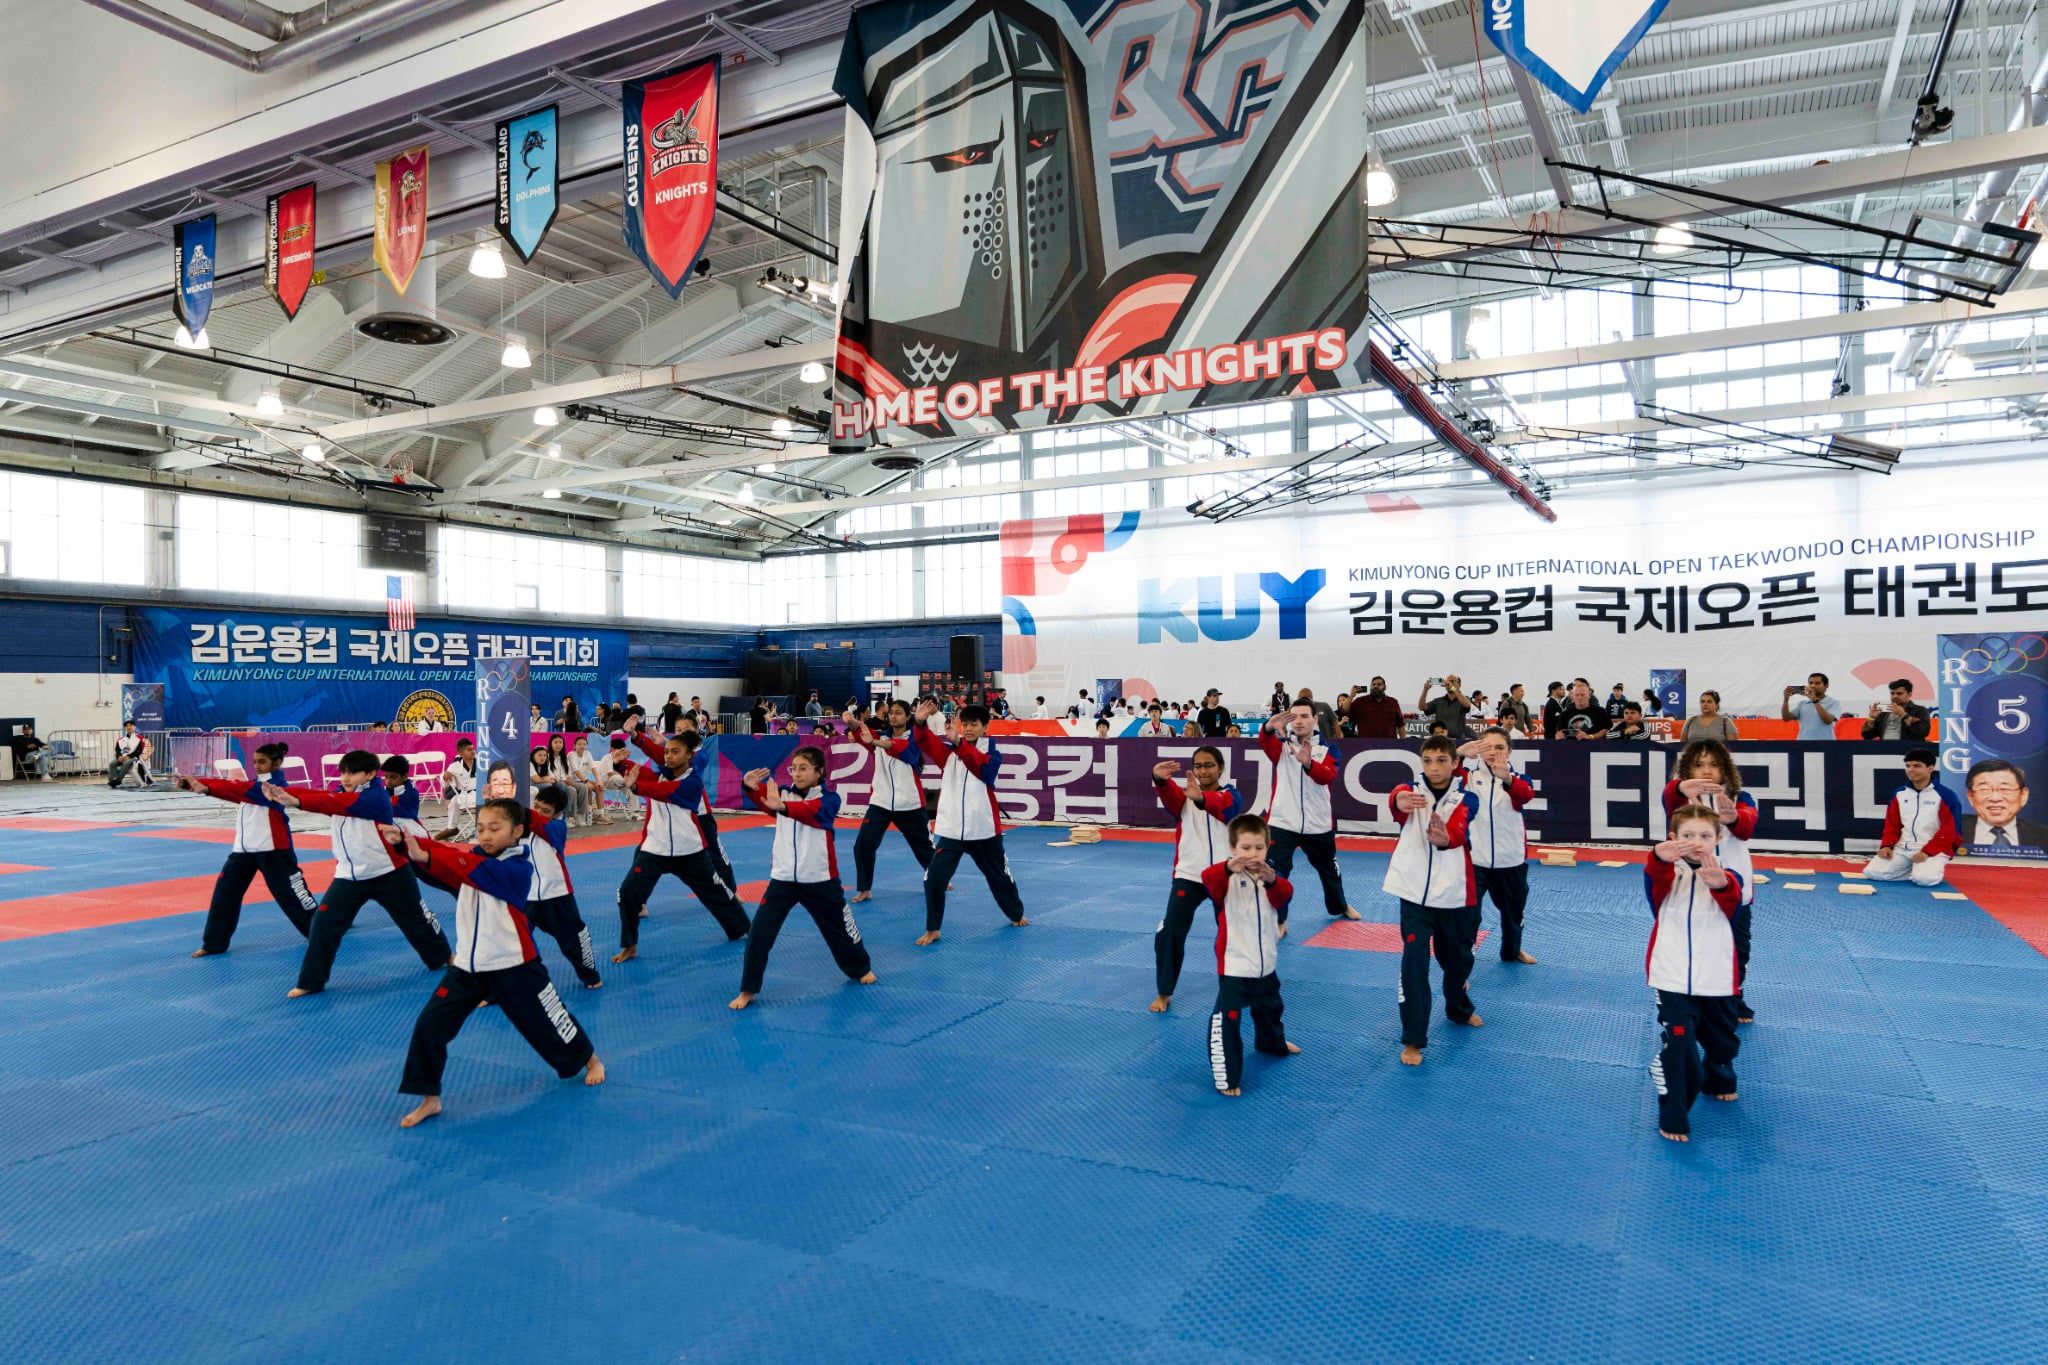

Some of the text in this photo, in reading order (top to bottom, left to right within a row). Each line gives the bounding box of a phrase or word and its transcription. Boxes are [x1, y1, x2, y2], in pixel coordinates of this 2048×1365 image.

[498, 127, 509, 225] STATEN ISLAND
[626, 123, 639, 207] QUEENS
[652, 148, 708, 175] KNIGHTS
[377, 187, 388, 240] MOLLOY
[515, 183, 552, 202] DOLPHINS
[655, 181, 708, 205] KNIGHTS
[268, 199, 278, 284] DISTRICT OF COLUMBIA
[397, 224, 417, 236] LIONS
[186, 281, 213, 295] WILDCATS
[833, 327, 1346, 440] HOME OF THE KNIGHTS
[1348, 529, 2036, 582] KIMUNYONG CUP INTERNATIONAL OPEN TAEKWONDO CHAMPIONSHIP
[1137, 568, 1327, 644] KUY
[1349, 584, 1553, 636] 김운용컵
[1577, 571, 1820, 634] 국제오픈
[190, 624, 599, 667] 김운용컵 국제오픈 태권도대회
[193, 668, 284, 681] KIMUNYONG
[286, 668, 316, 681] CUP
[317, 669, 416, 682] INTERNATIONAL
[419, 670, 452, 681] OPEN
[530, 671, 598, 682] HAMPIONSHIPS
[1668, 691, 1680, 705] 2
[476, 678, 491, 771] RING
[501, 711, 519, 740] 4
[1941, 657, 1973, 774] RING
[1994, 694, 2031, 735] 5
[537, 981, 578, 1044] BROOKFIELD
[1210, 1011, 1229, 1090] TAEKWONDO
